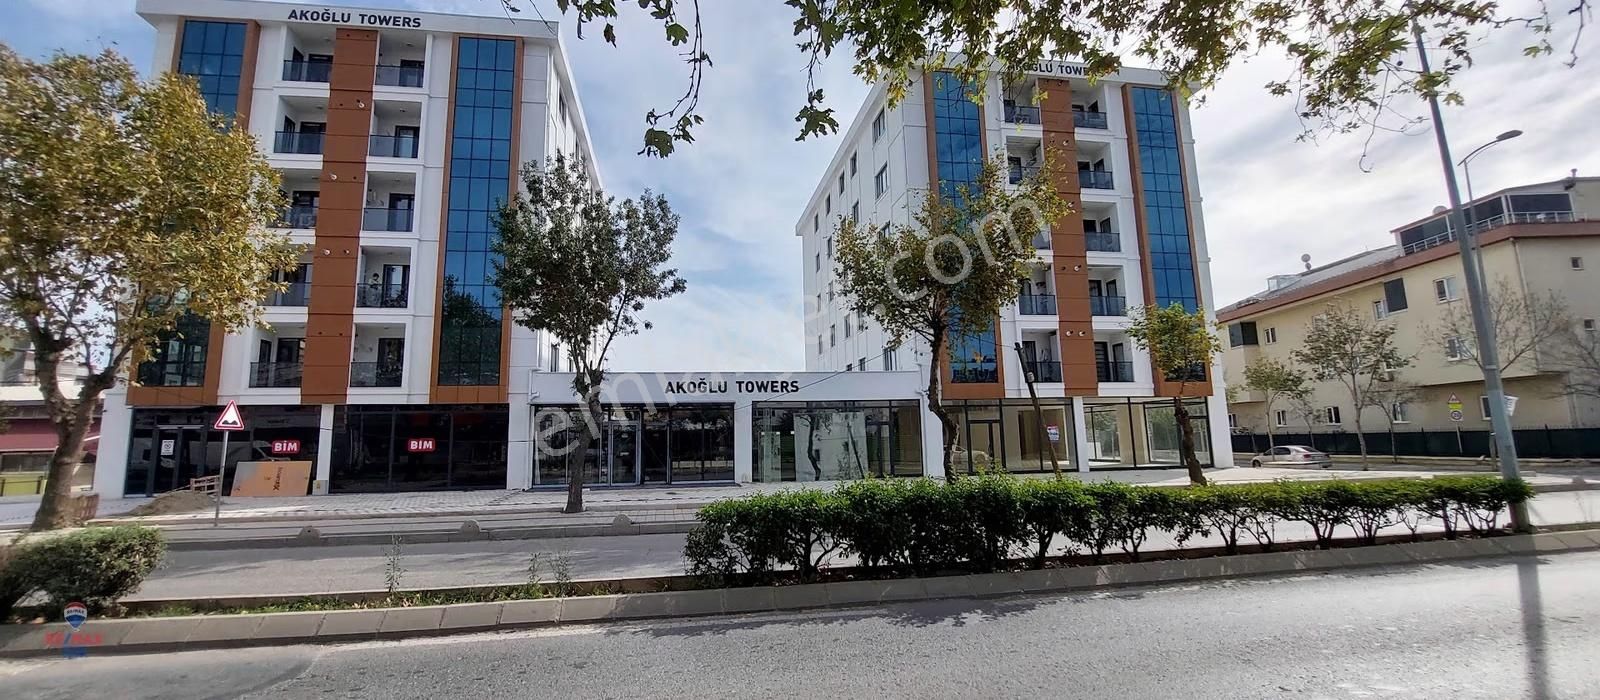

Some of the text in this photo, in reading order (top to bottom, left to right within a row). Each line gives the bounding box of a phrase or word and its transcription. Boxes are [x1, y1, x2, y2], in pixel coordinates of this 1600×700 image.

[288, 8, 421, 28] AKOĞLU TOWERS
[1058, 64, 1094, 77] TOWE
[665, 378, 799, 394] AKOĞLU TOWERS
